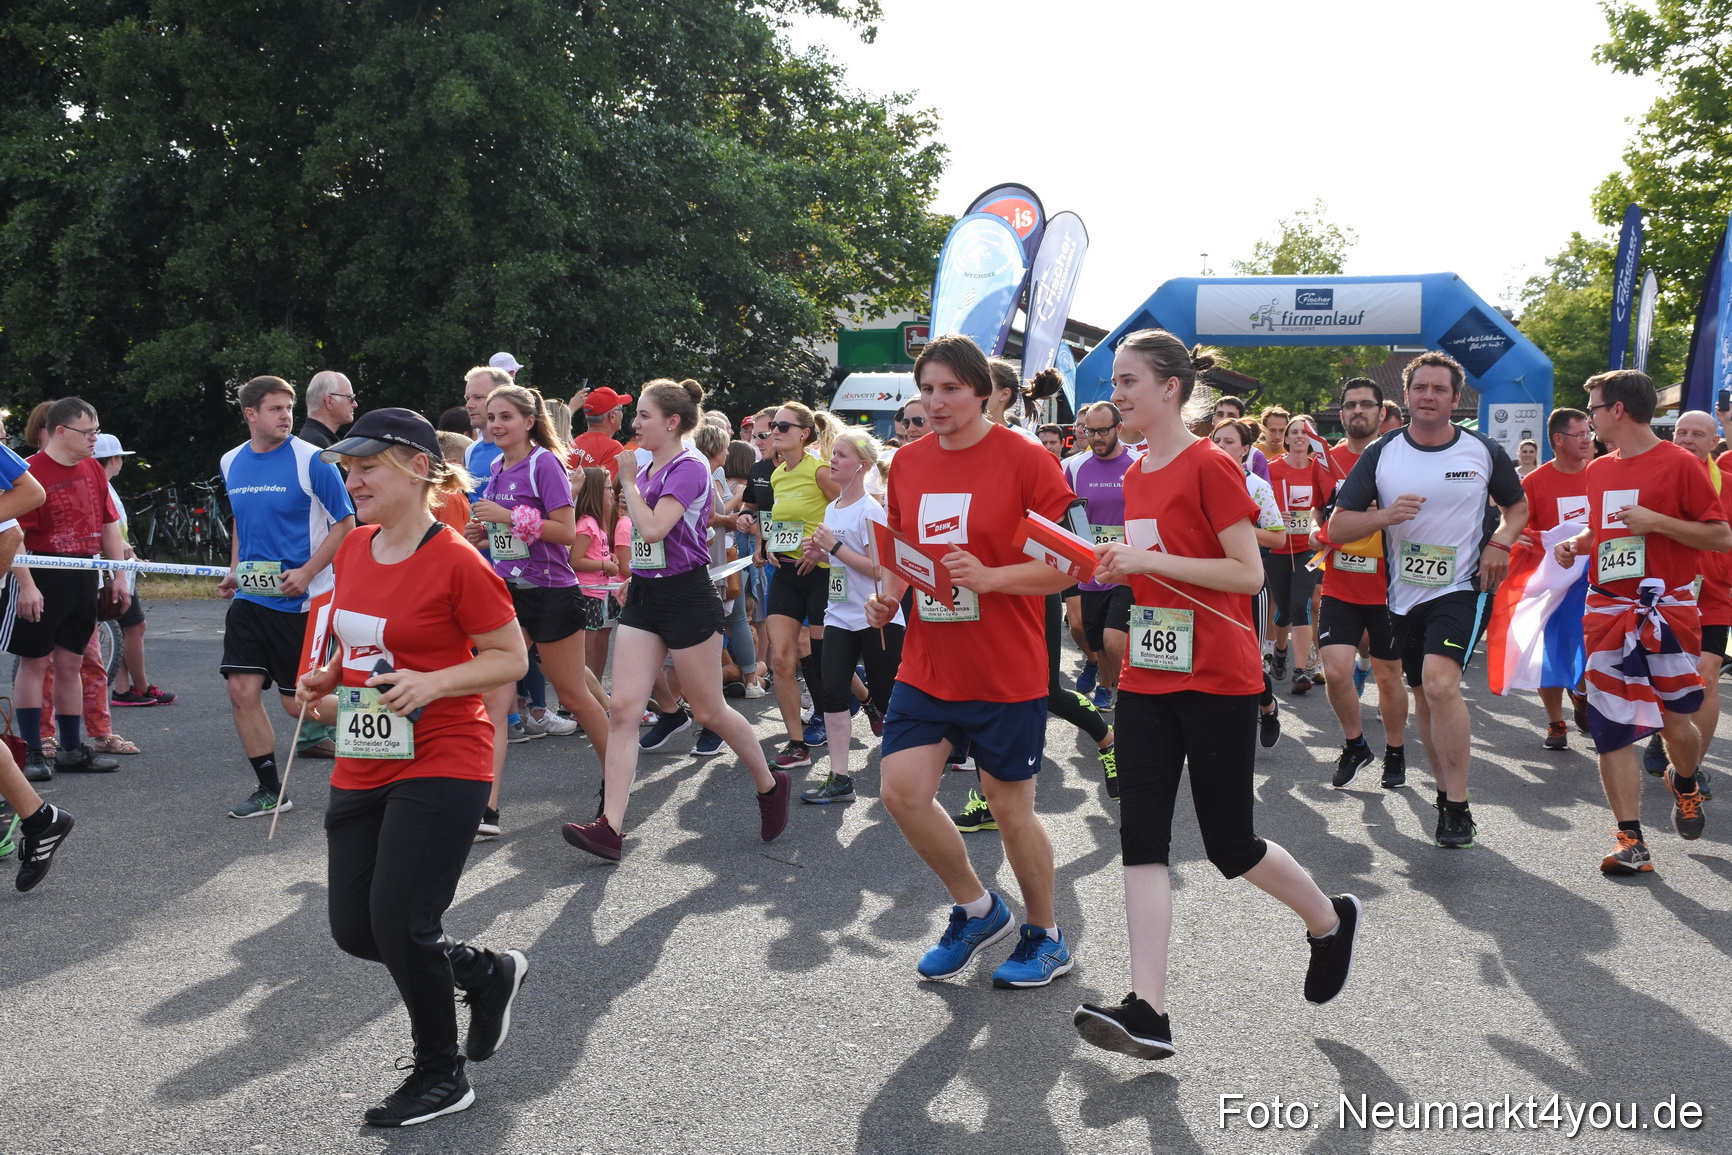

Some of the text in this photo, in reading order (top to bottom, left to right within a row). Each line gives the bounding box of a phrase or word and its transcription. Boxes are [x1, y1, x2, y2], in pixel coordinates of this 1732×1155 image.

[1036, 231, 1073, 308] Fischer
[1056, 241, 1077, 302] AUTOMOBILE
[1302, 293, 1332, 304] Fischer
[1281, 310, 1365, 326] firmenlauf
[841, 392, 876, 400] abavent
[1444, 471, 1469, 479] swn
[229, 485, 287, 496] energiegeladen
[934, 522, 952, 533] DEHN
[1290, 520, 1308, 528] 513
[493, 535, 513, 550] 897
[774, 533, 799, 544] 1235
[1404, 556, 1448, 576] 2276
[1601, 551, 1637, 572] 2445
[240, 574, 276, 588] 2151
[1141, 629, 1177, 654] 468
[1140, 652, 1179, 662] Bohlmann Katja
[348, 713, 392, 740] 480
[352, 739, 383, 748] Schneider
[384, 740, 401, 749] Olga
